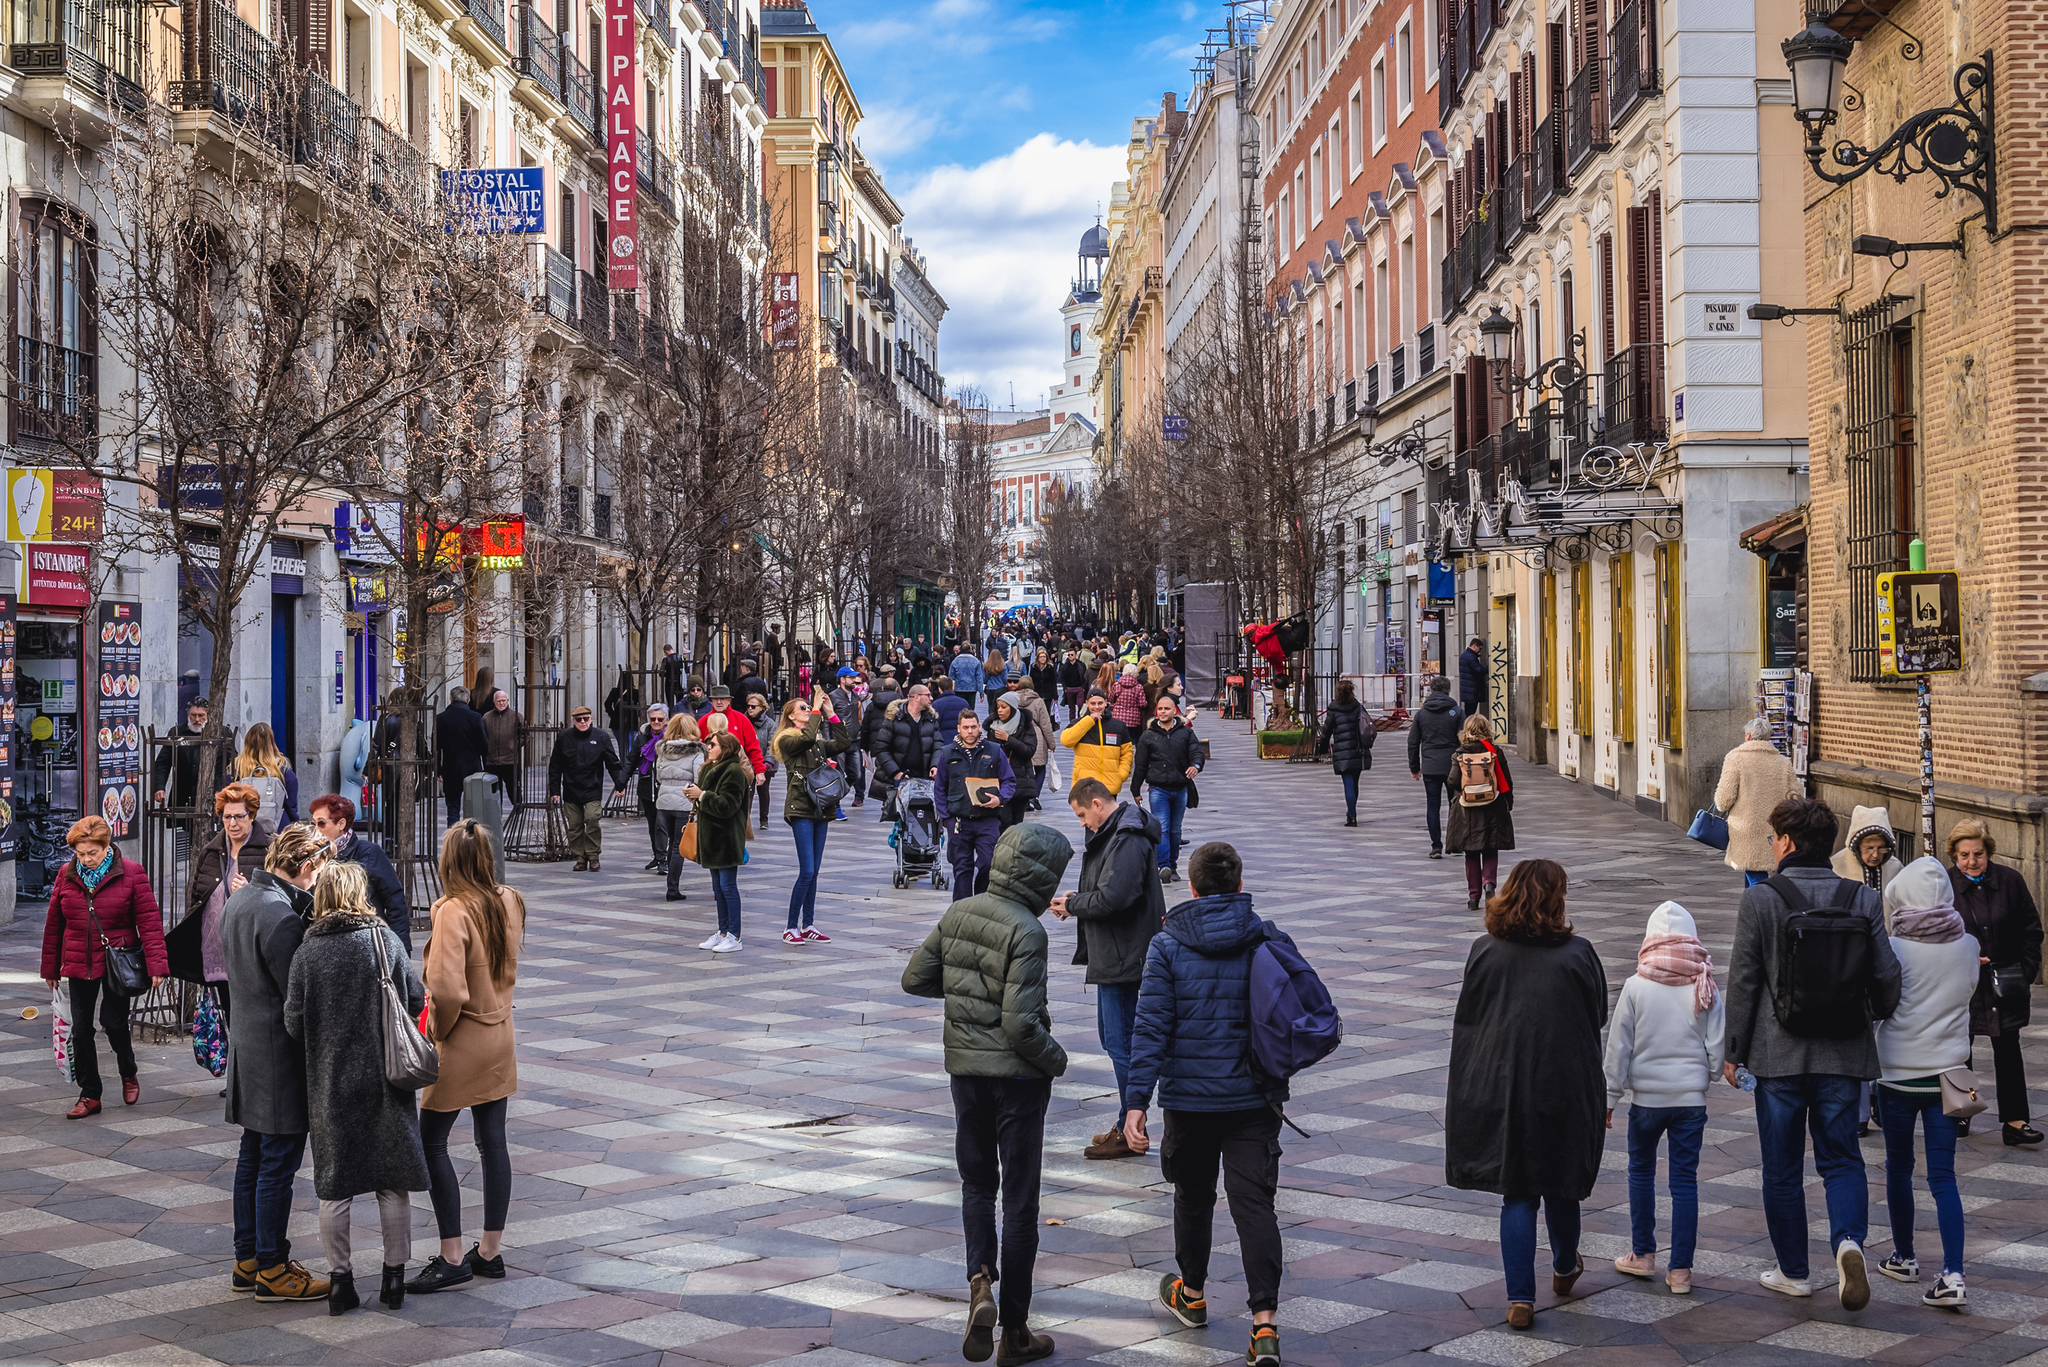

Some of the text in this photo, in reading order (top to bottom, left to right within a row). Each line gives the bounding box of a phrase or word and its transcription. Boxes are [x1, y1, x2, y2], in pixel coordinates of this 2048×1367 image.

[612, 55, 631, 221] PALACE
[458, 172, 530, 189] HOSTAL
[1705, 304, 1737, 313] PASADIZO
[55, 486, 102, 494] ISTANBUL
[61, 516, 96, 531] 24H
[32, 551, 87, 573] ISTANBUL
